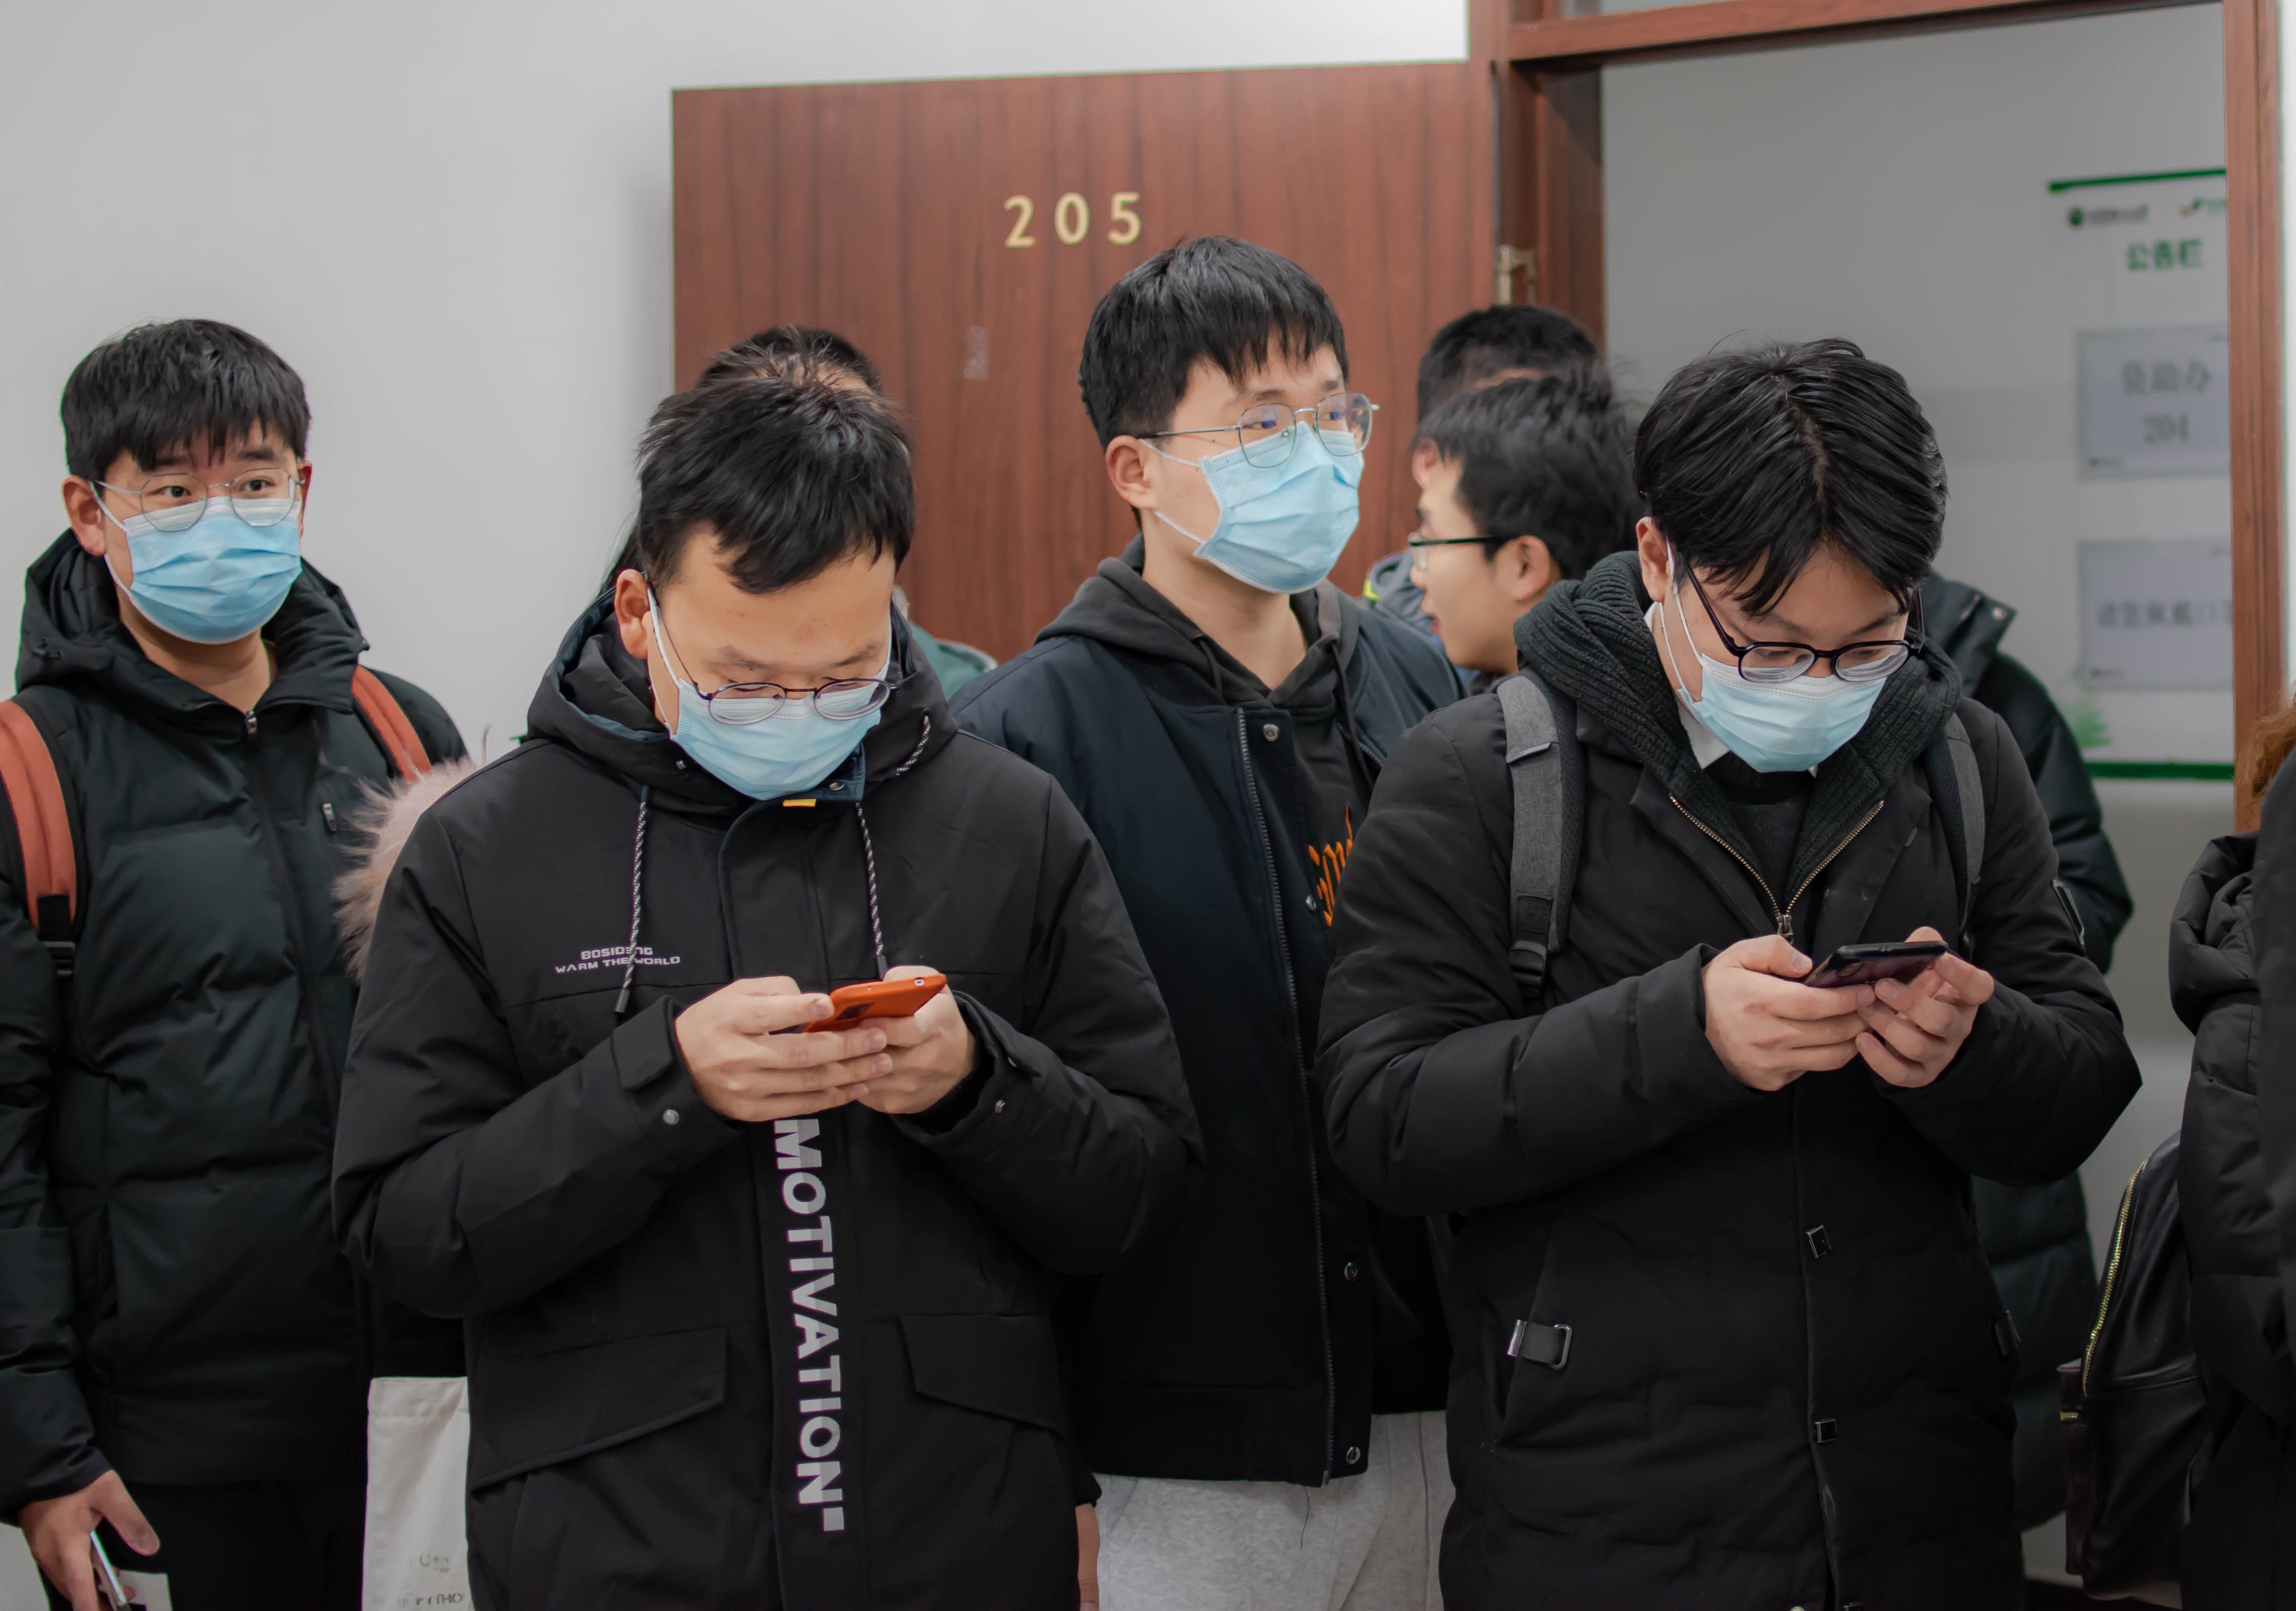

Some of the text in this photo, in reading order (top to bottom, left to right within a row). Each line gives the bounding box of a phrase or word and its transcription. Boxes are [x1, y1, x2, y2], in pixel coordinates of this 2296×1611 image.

[1004, 192, 1142, 247] 205
[555, 956, 681, 973] WARM THE WORLD
